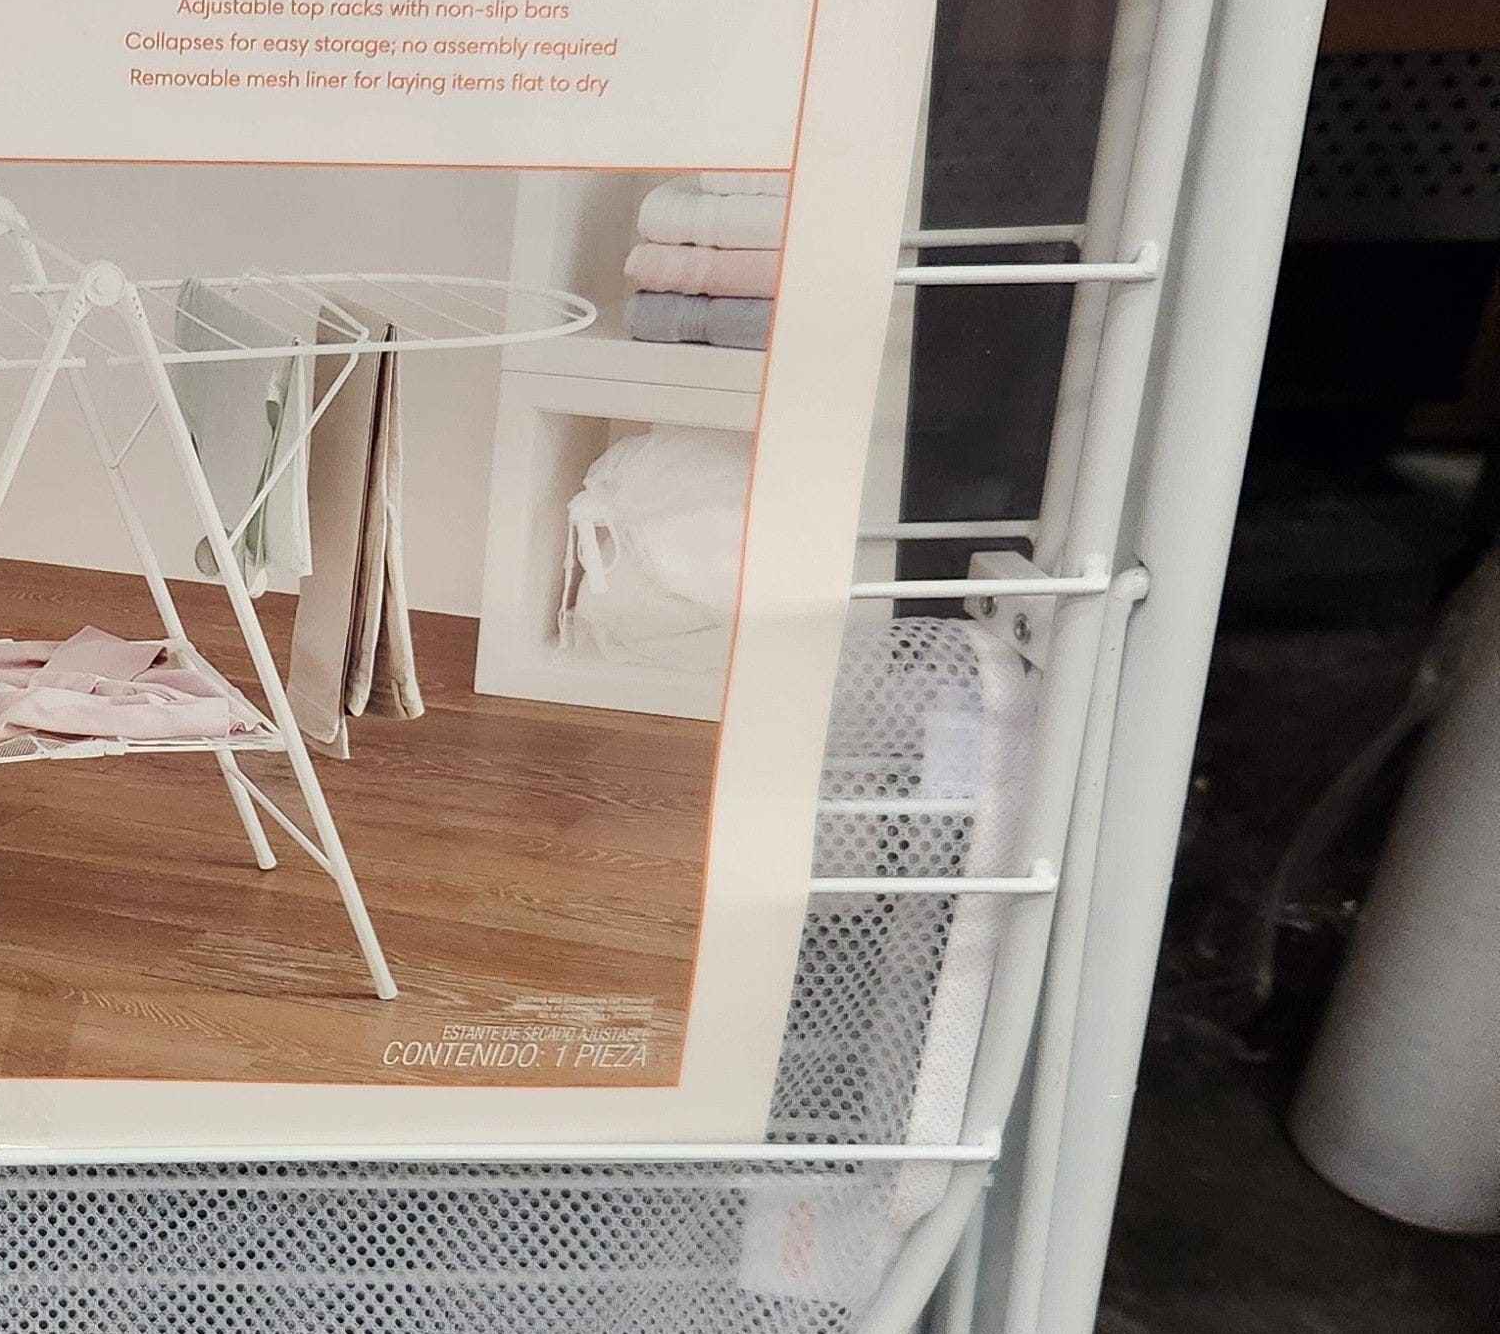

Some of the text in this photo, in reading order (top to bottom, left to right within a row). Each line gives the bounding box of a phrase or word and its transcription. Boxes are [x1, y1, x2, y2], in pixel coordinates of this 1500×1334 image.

[331, 0, 382, 17] racks
[390, 0, 429, 17] with
[436, 0, 518, 23] non-slip
[525, 0, 569, 18] bars
[125, 32, 618, 59] Collapses for easy storage; no assembly required
[130, 68, 609, 96] Removable mesh liner for laying items flat to dry
[442, 1026, 501, 1040] ESTANTE
[383, 1041, 647, 1067] CONTENIDO: 1 PIEZA
